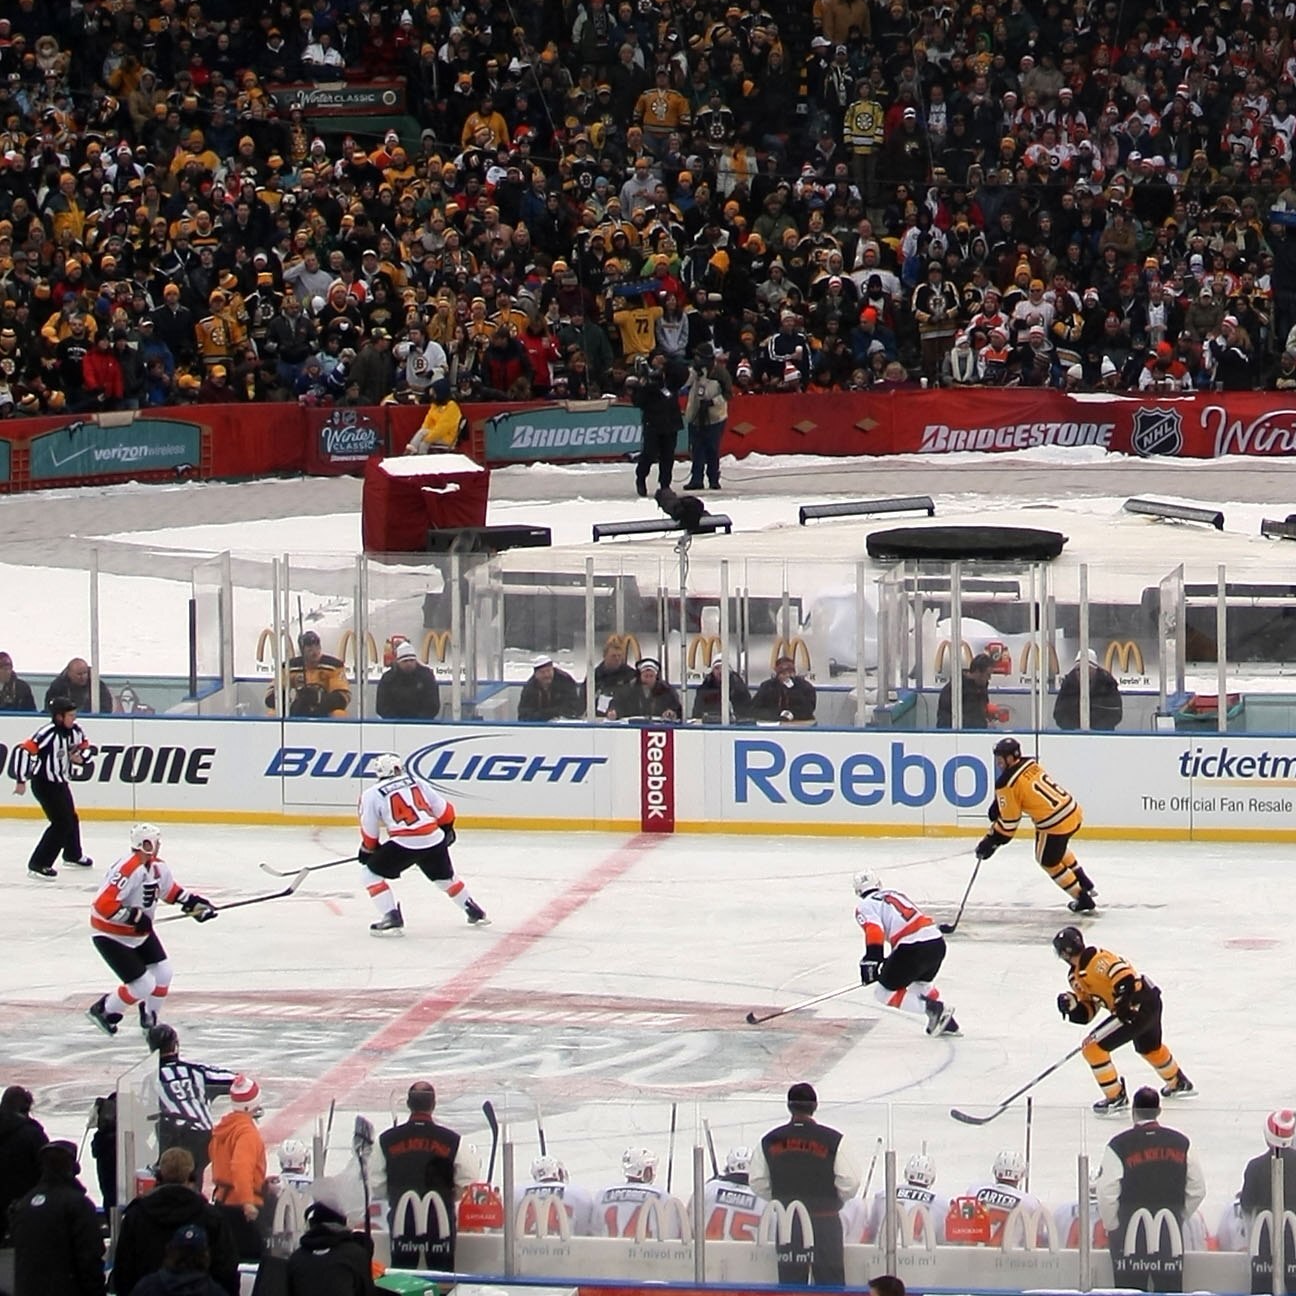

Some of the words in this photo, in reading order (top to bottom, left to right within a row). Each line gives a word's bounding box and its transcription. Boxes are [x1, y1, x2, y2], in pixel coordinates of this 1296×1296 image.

[296, 90, 333, 107] Winter
[334, 94, 375, 103] CLASSIC
[322, 426, 377, 453] Winter
[333, 441, 375, 451] CLASSIC
[510, 425, 643, 449] BRIDGESTO
[920, 423, 1115, 454] BRIDGESTONE
[1143, 423, 1172, 448] NHL
[428, 751, 608, 784] LIGHT
[646, 731, 667, 820] Reebok
[734, 739, 989, 809] Reebo
[389, 784, 435, 827] 44
[1142, 797, 1166, 812] The
[1220, 797, 1244, 813] Fan
[1248, 797, 1293, 813] Resale
[110, 871, 128, 889] 20
[897, 1188, 931, 1202] BETTS
[978, 1190, 1017, 1208] CARTER
